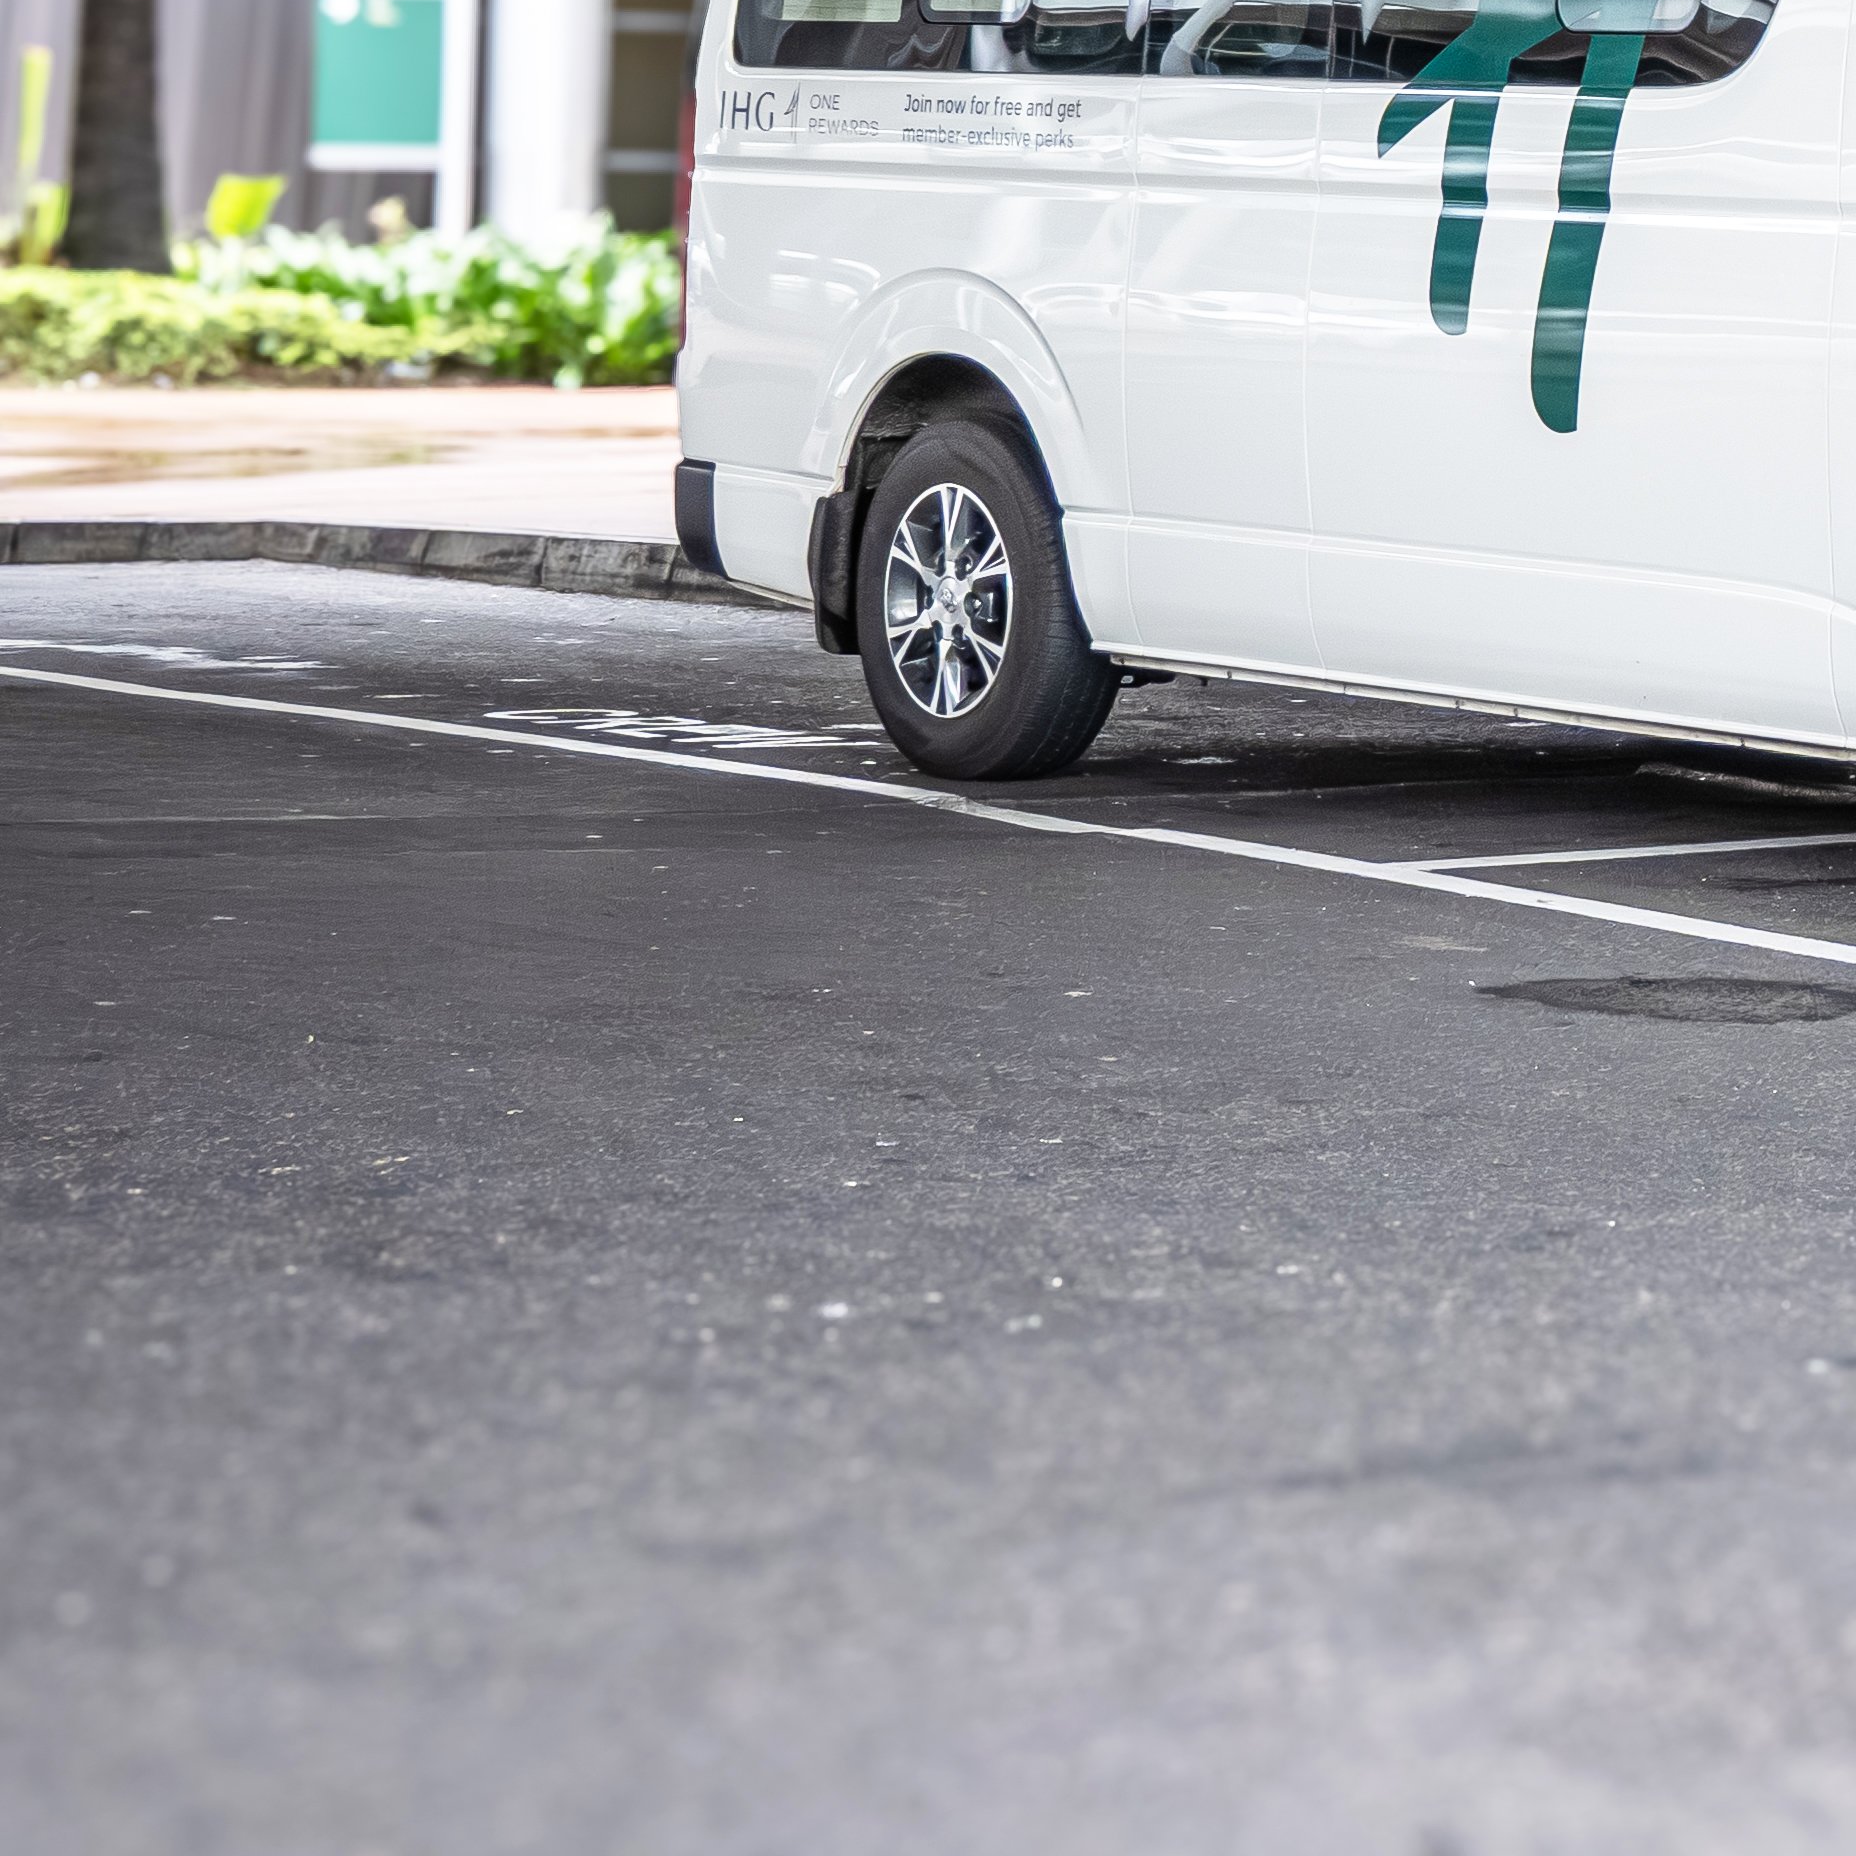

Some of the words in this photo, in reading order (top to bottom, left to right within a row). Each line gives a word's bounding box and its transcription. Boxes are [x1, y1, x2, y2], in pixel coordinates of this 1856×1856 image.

[719, 90, 776, 132] IHG
[809, 93, 841, 111] ONE
[903, 93, 932, 113] Join
[936, 99, 967, 114] now
[970, 95, 991, 115] for
[994, 96, 1023, 116] free
[1026, 97, 1054, 118] and
[1057, 99, 1082, 123] get
[808, 117, 880, 137] REWARDS
[902, 124, 1032, 147] member-exclusive
[1035, 128, 1075, 151] perks
